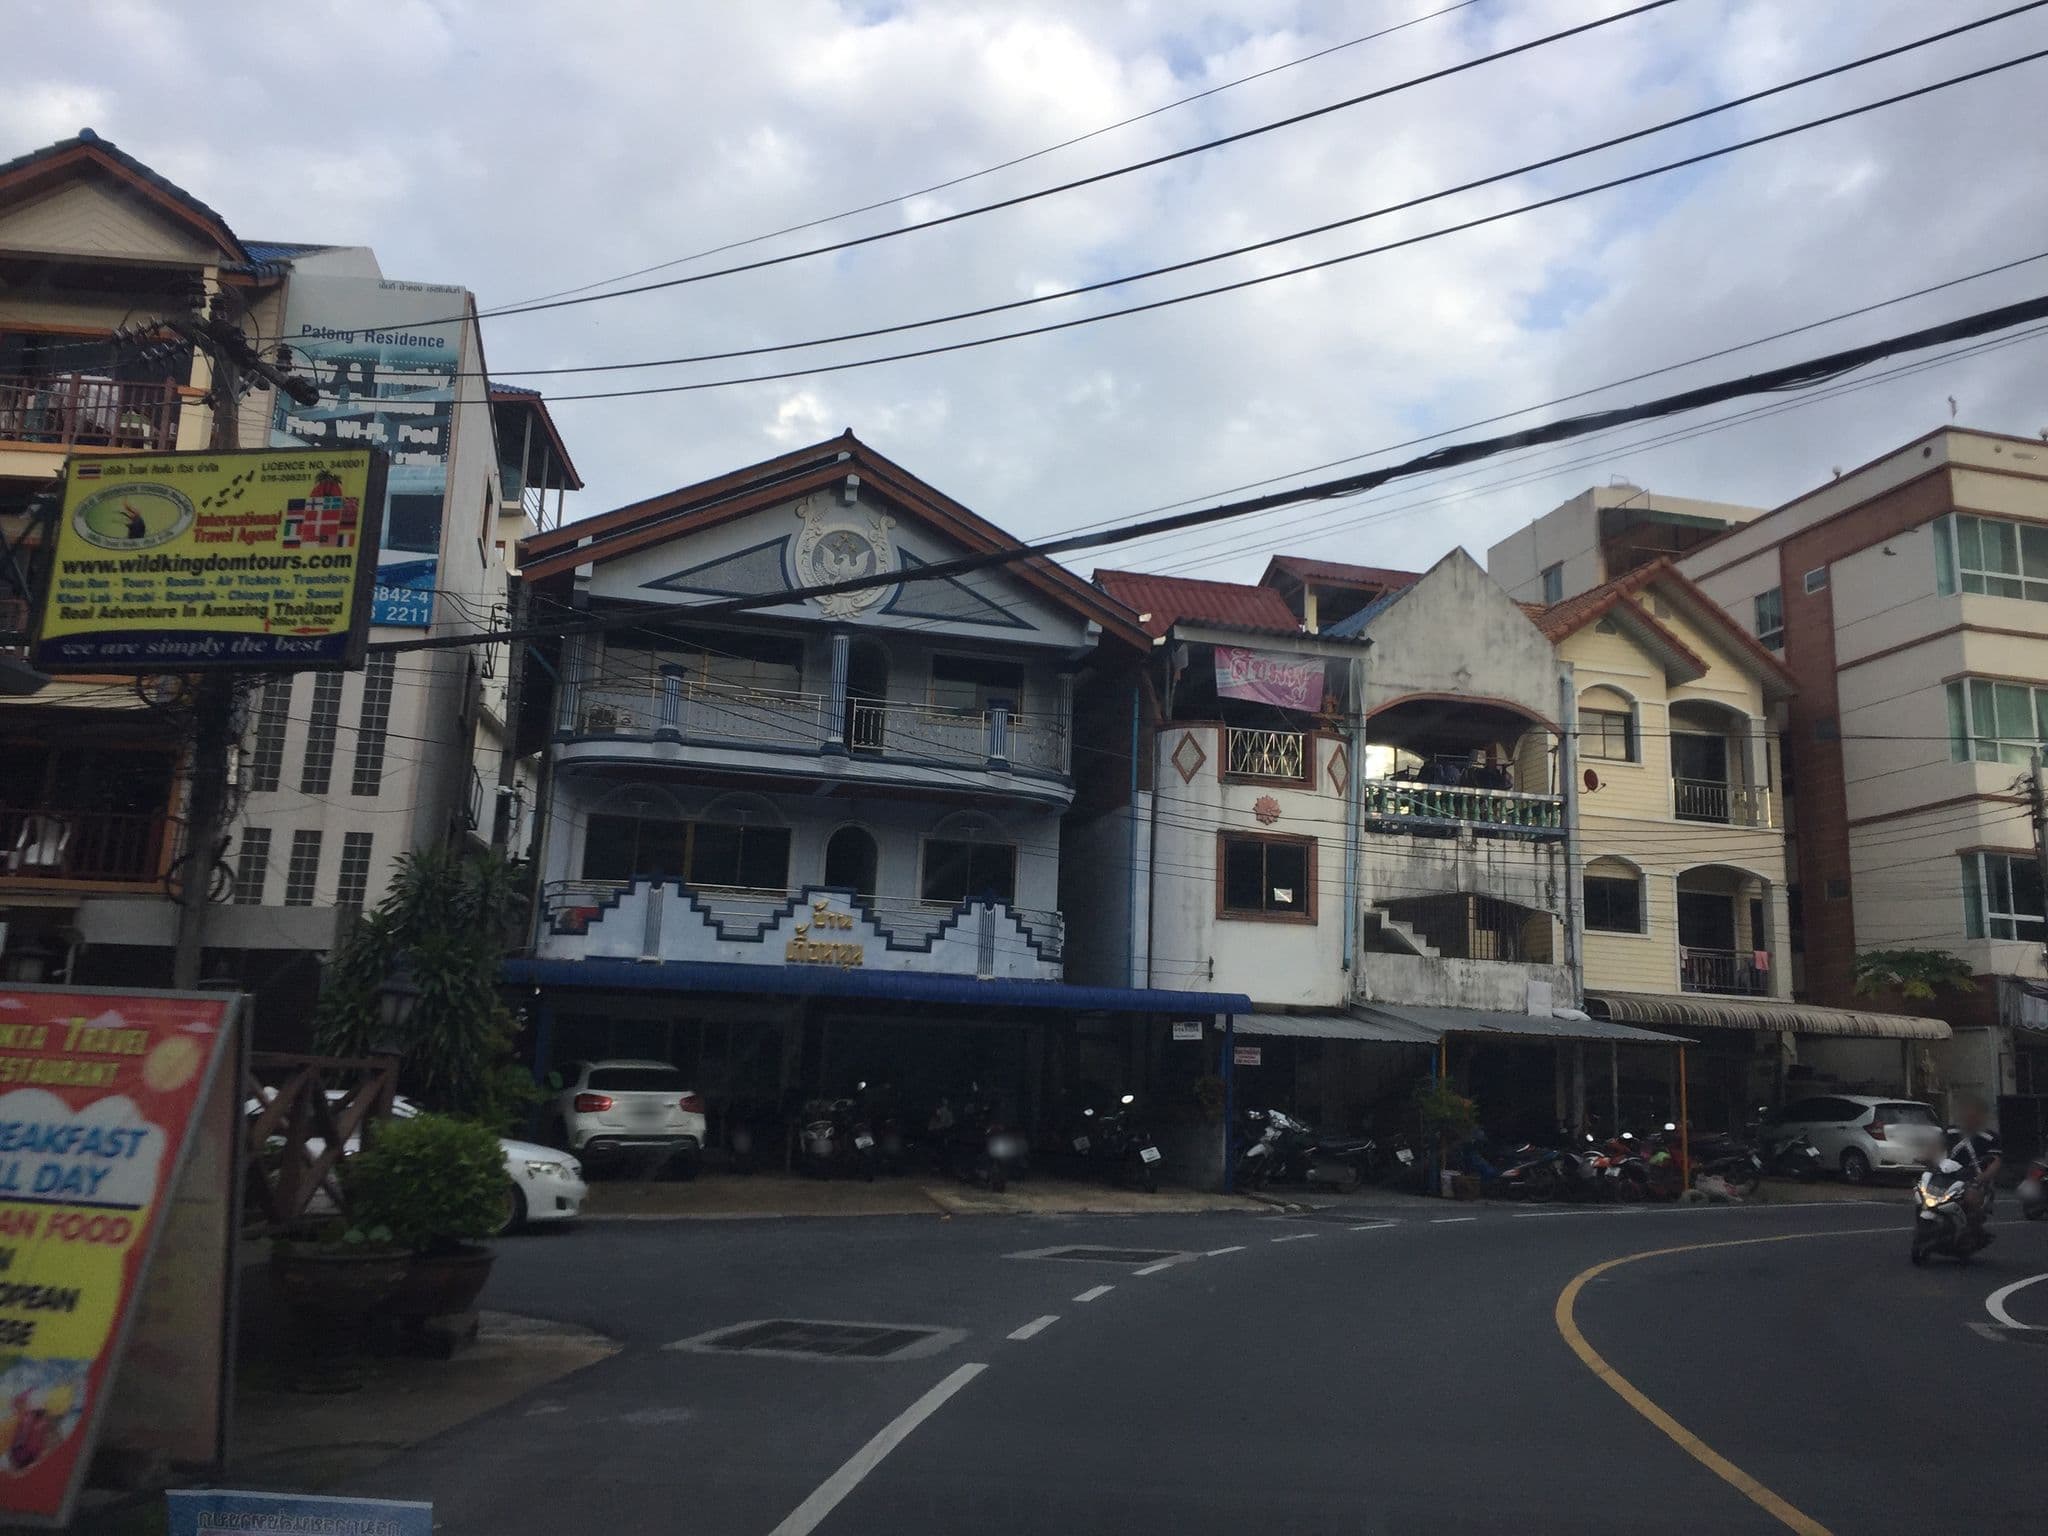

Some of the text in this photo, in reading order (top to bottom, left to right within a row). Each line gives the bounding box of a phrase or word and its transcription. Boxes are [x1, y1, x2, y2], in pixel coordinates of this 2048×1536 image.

[301, 324, 445, 348] Patong Residence
[398, 424, 439, 445] Pool
[262, 461, 305, 471] LICENCE
[62, 552, 352, 575] www.wildkingdomtours.com
[293, 574, 350, 584] Transfers
[60, 606, 94, 620] Real
[98, 605, 178, 620] Adventure
[202, 602, 269, 620] Amazing
[274, 601, 343, 616] Thailand
[386, 606, 428, 623] 2211
[146, 637, 225, 657] simply
[275, 636, 322, 652] best
[31, 1162, 113, 1197] DAY
[43, 1211, 134, 1245] FOOD
